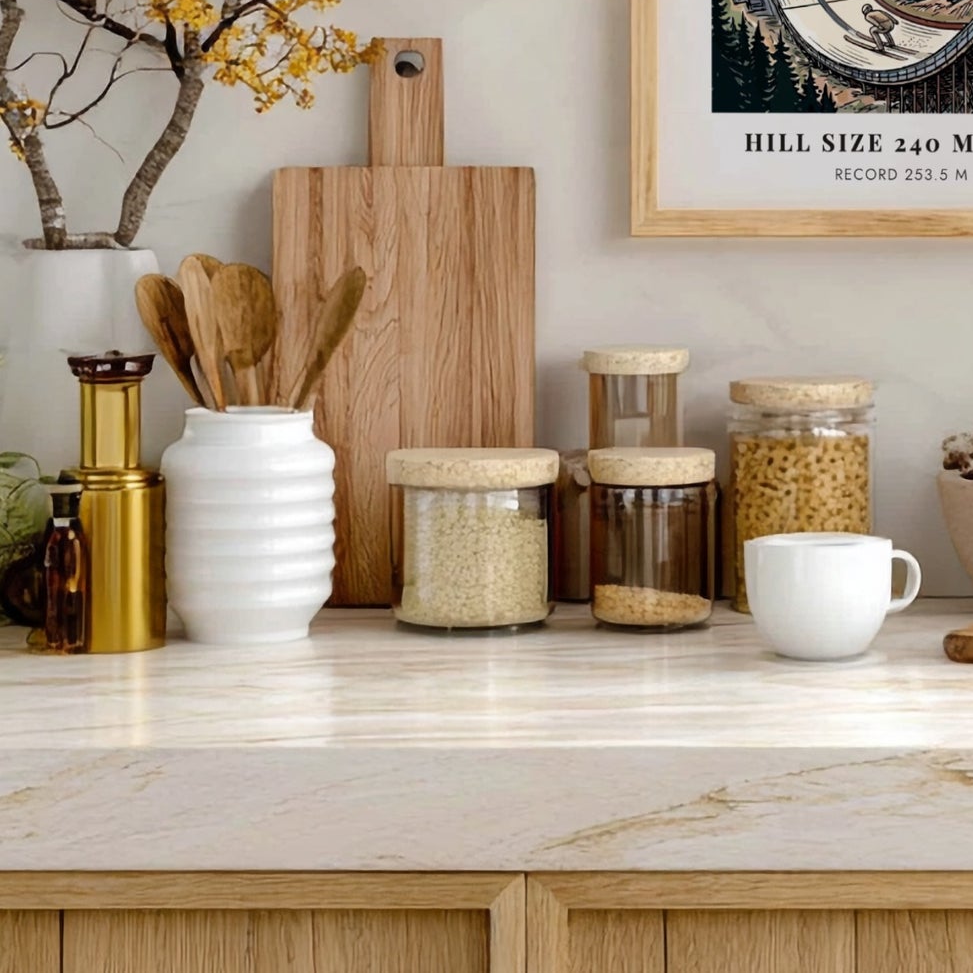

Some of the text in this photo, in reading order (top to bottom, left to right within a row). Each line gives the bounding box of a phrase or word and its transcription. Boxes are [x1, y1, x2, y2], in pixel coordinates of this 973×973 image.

[744, 132, 811, 154] HILL
[821, 132, 883, 154] SIZE
[894, 136, 941, 156] 240
[952, 132, 973, 154] M
[834, 167, 898, 181] RECORD
[904, 167, 949, 181] 253.5
[955, 168, 968, 181] M
